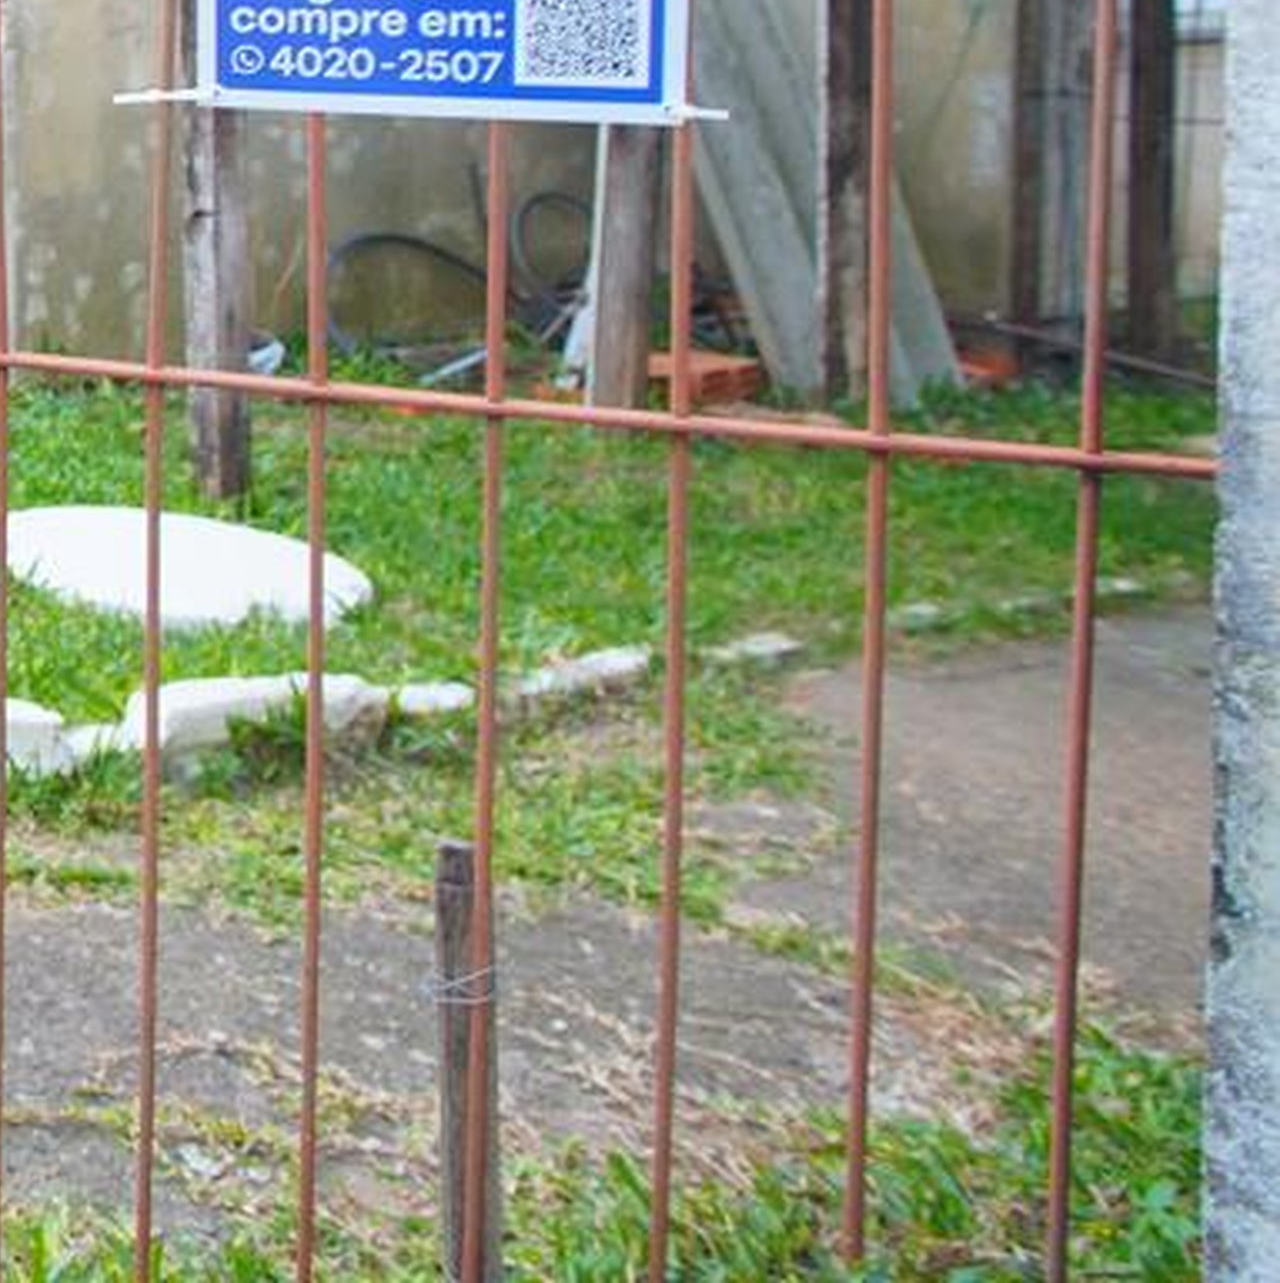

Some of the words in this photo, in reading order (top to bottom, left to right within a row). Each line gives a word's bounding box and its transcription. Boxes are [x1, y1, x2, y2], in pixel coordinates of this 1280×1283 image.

[230, 6, 408, 43] compre
[418, 9, 507, 38] em:
[269, 46, 505, 83] 4020-2507
